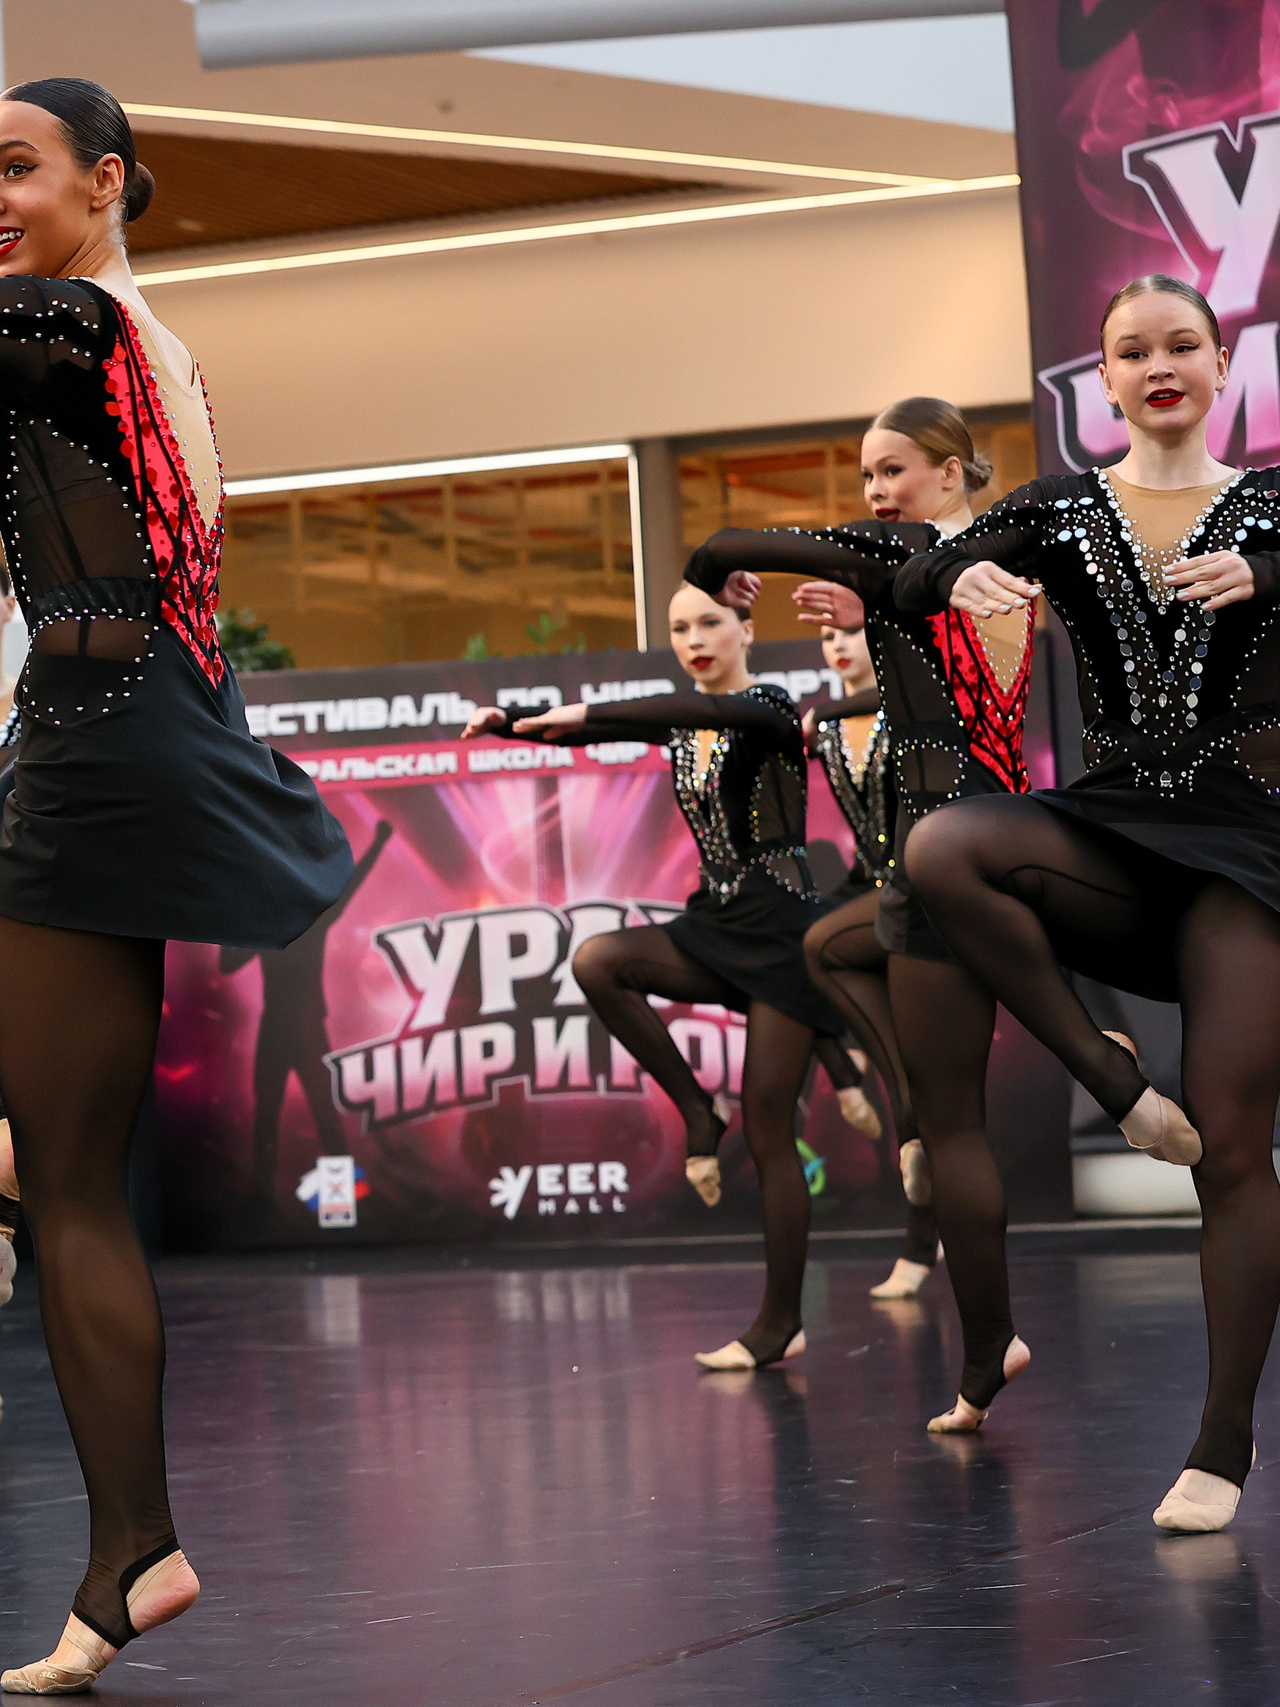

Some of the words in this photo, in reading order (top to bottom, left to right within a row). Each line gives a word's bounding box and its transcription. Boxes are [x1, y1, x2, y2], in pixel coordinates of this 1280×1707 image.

[244, 692, 477, 737] ЕСТИВАЛЬ
[294, 751, 458, 783] РАЛЬСКАЯ
[468, 746, 574, 772] ШКОЛА
[585, 741, 650, 765] ЧИР
[339, 1021, 516, 1120] ЧИР
[533, 1015, 592, 1090] И
